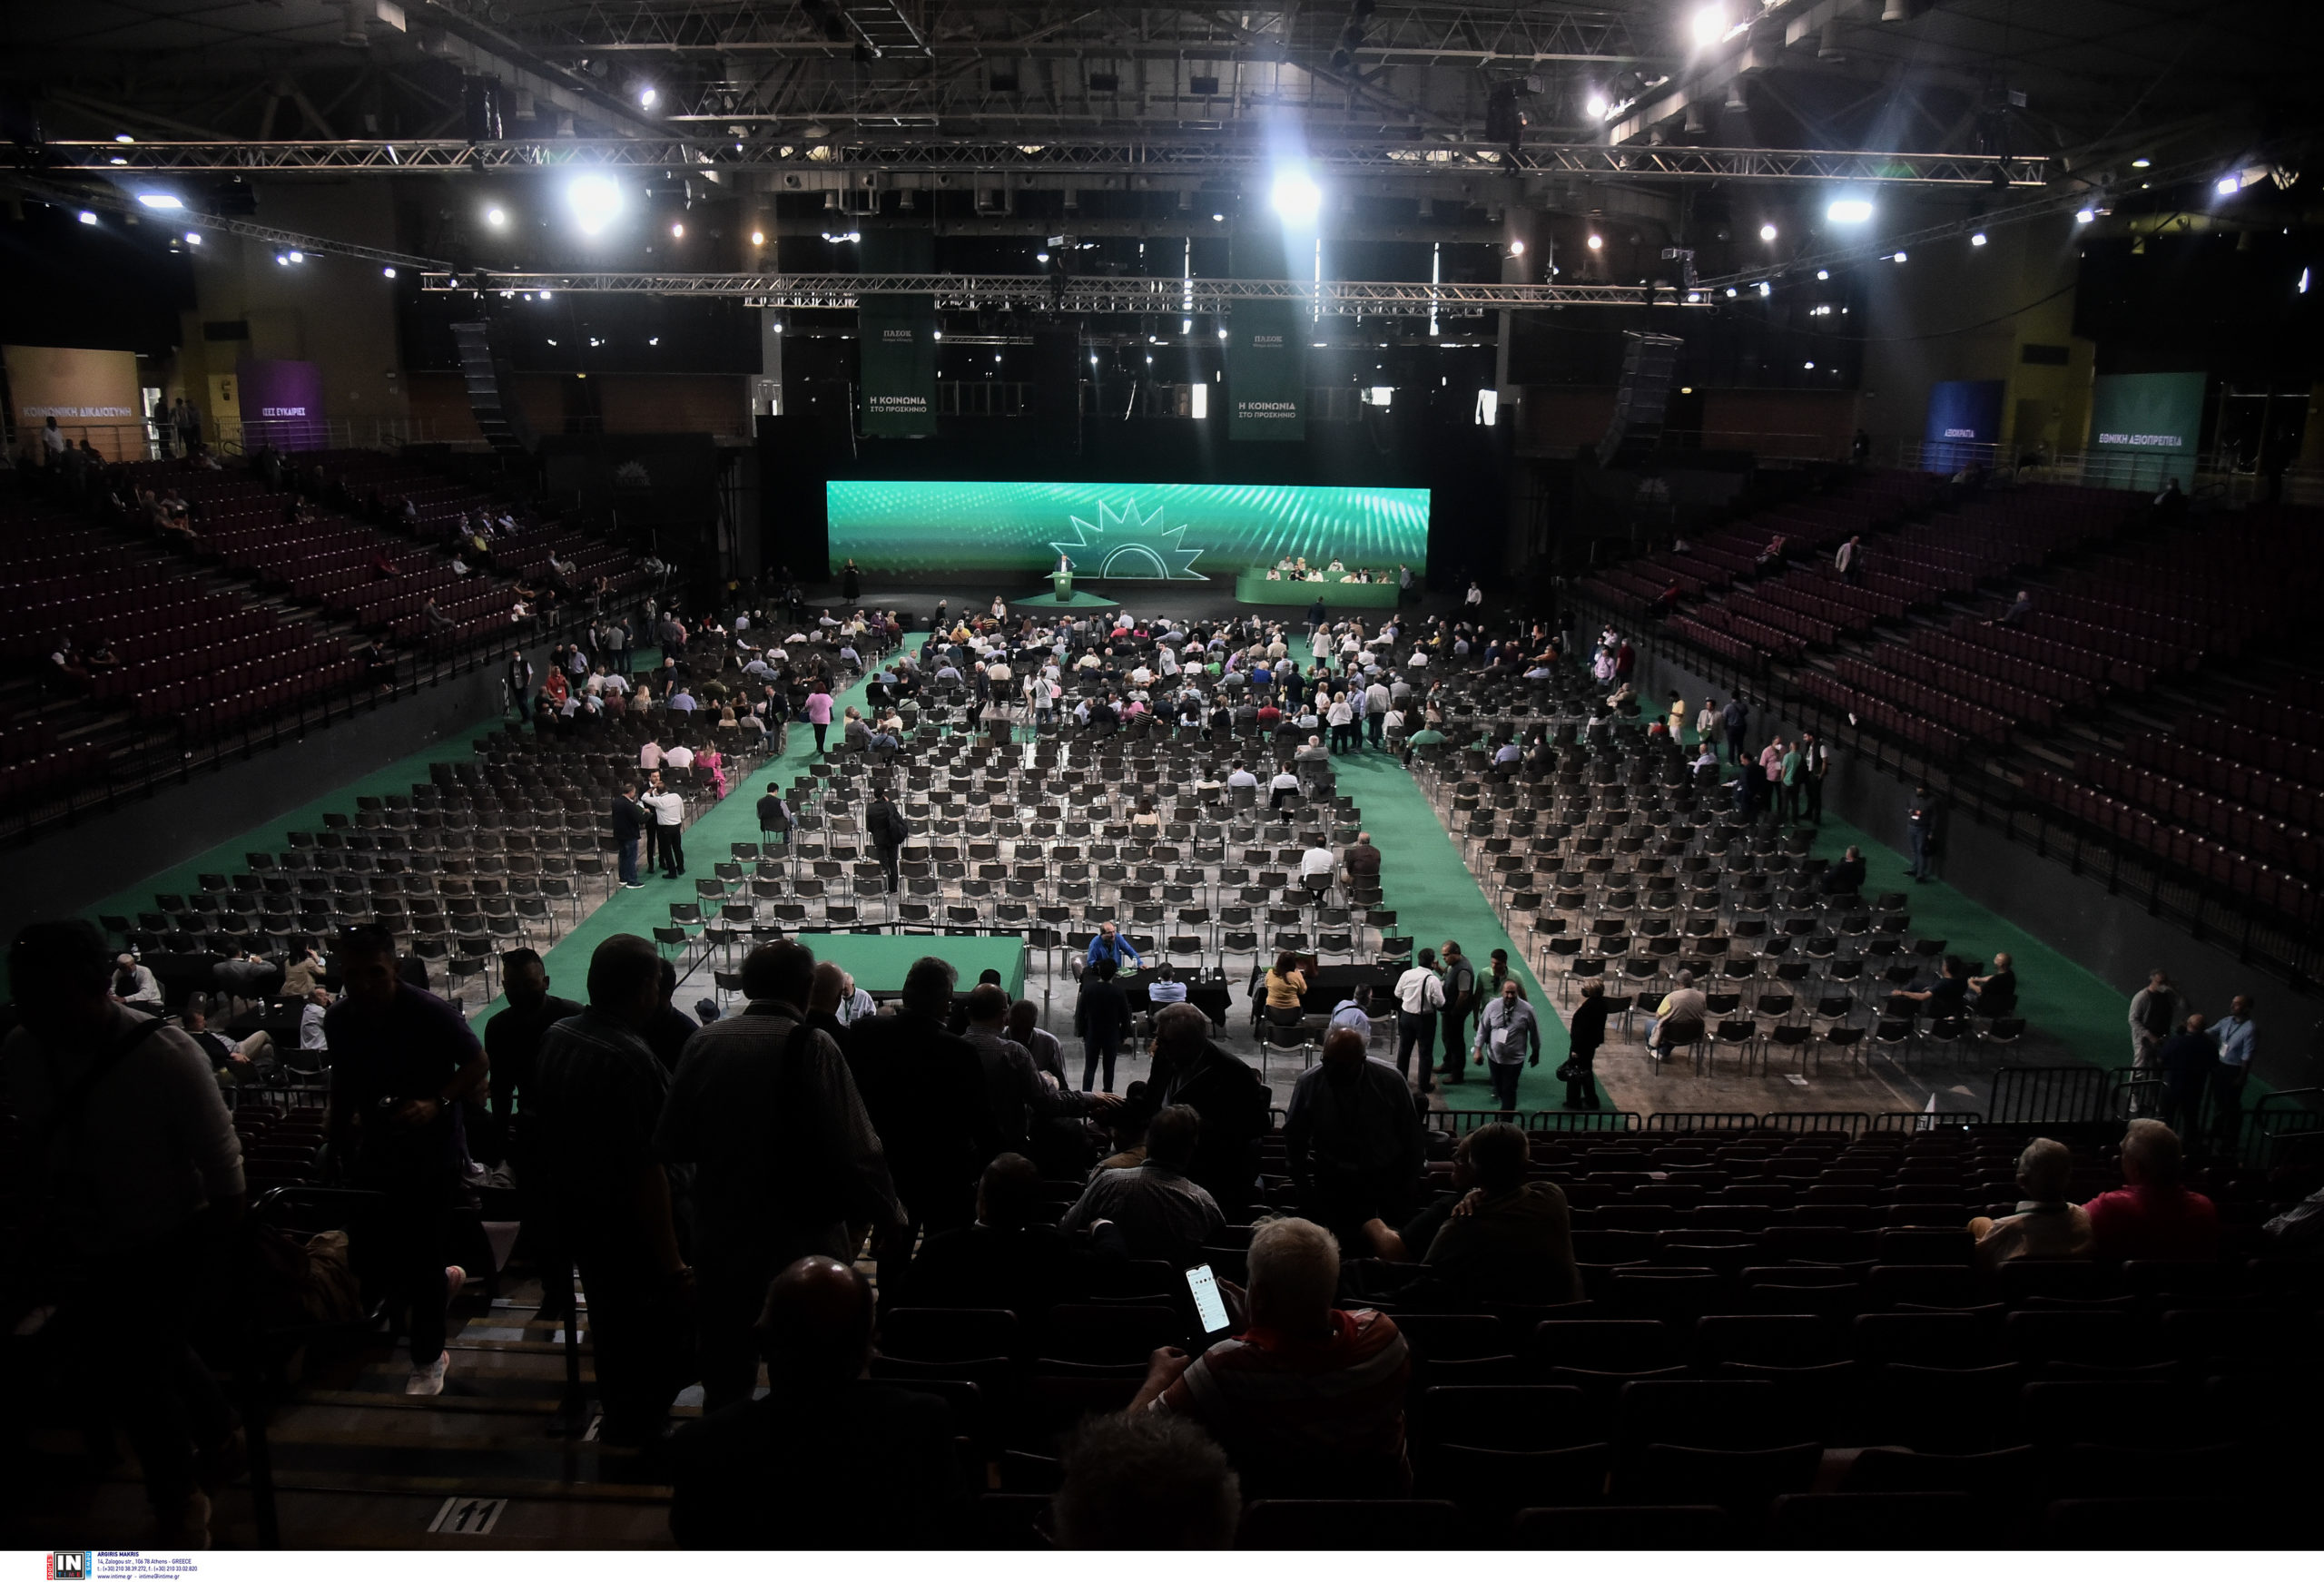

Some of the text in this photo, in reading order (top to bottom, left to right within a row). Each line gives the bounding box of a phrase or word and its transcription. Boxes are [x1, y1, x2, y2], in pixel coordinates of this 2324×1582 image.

[870, 397, 927, 405] Η ΚΟΙΝΩΝΙΑ
[1238, 402, 1296, 410] Η ΚΟΙΝΩΝΙΑ
[23, 407, 132, 418] ΚΟΙΝΩΝΙΚΗ ΔΙΚΑΙΟΣΥΝΗ
[276, 408, 306, 417] ΕΥΚΑΙΡΙΕΣ
[2099, 433, 2128, 444] ΕΘΝΙΚΗ
[455, 1500, 498, 1533] 11
